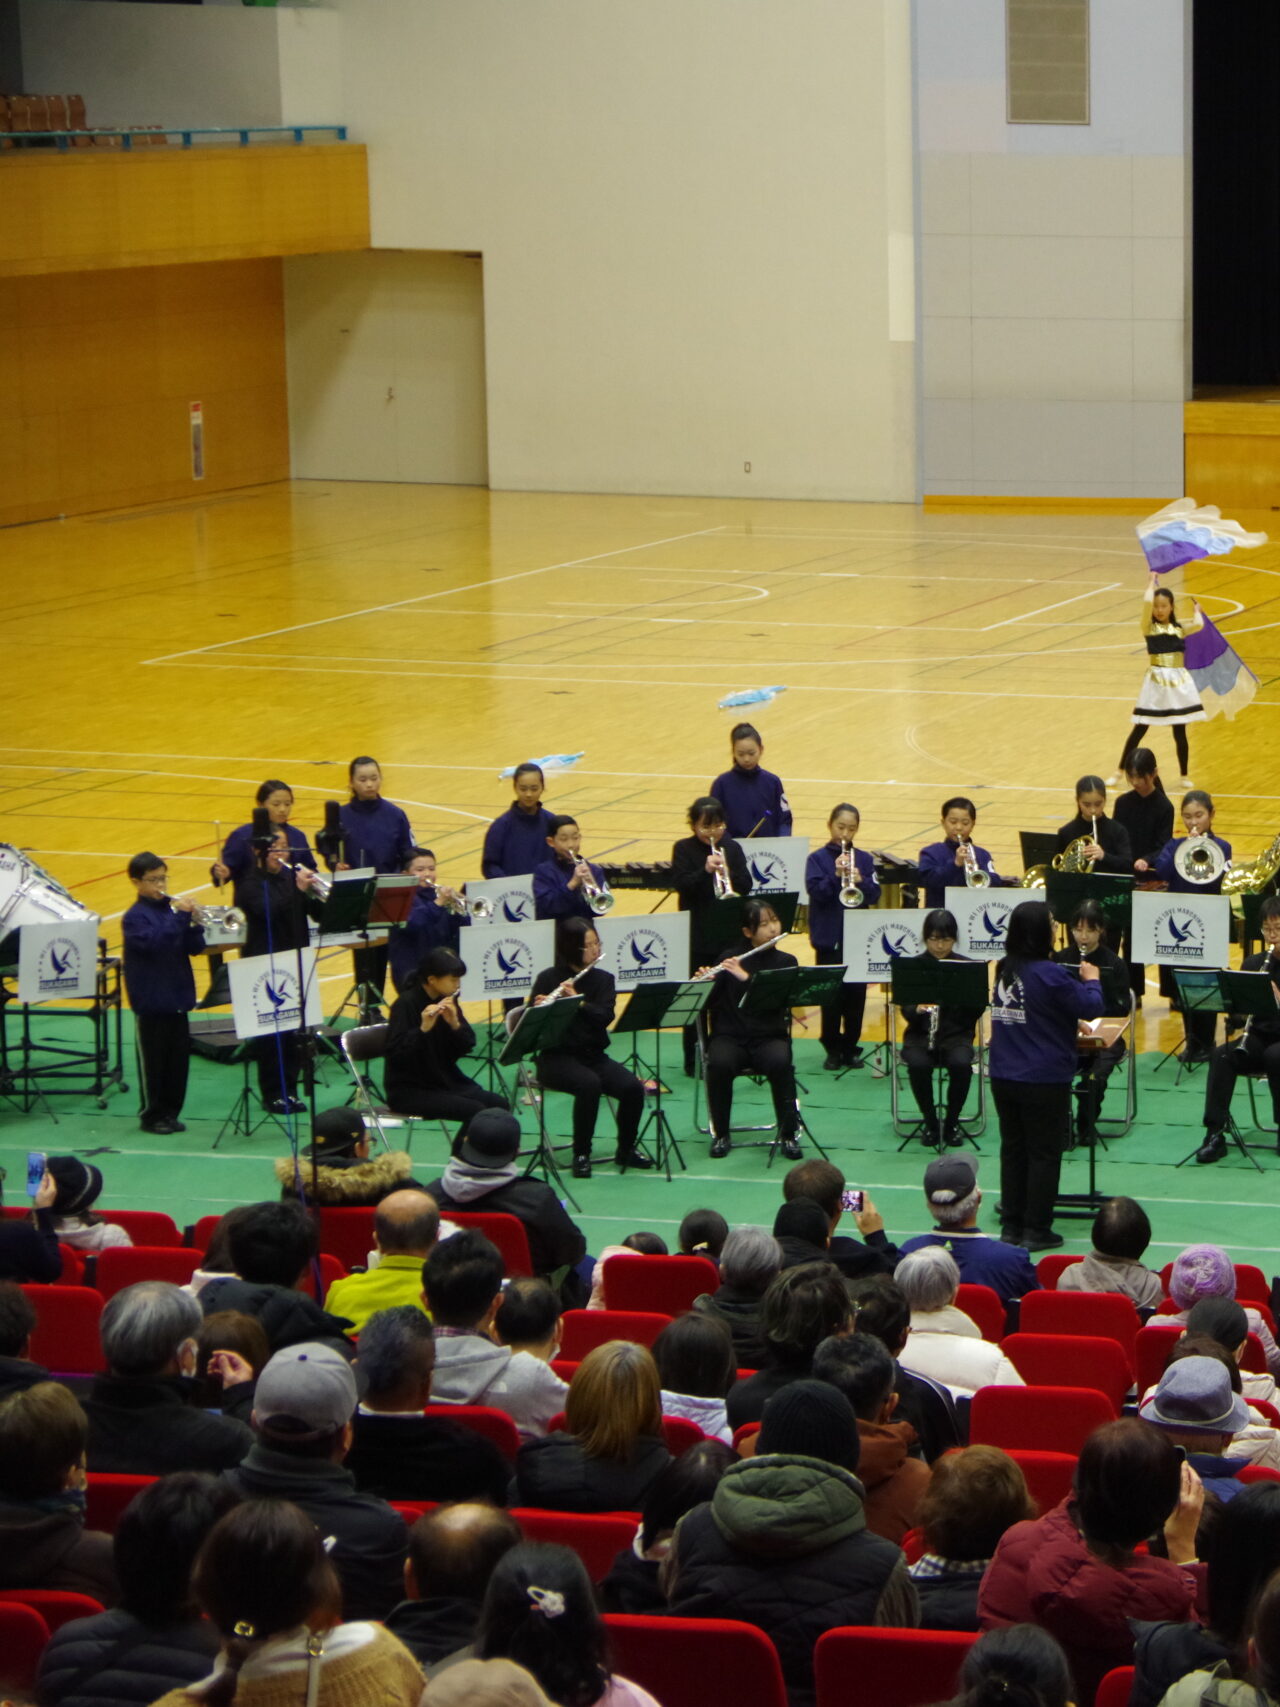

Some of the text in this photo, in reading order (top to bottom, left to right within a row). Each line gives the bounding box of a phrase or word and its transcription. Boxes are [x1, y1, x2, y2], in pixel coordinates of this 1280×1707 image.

[1156, 946, 1203, 956] SUKAGAWA
[869, 963, 892, 971] SUKA
[619, 968, 665, 979] SUKAGAWA
[485, 978, 531, 989] SUKAGAWA
